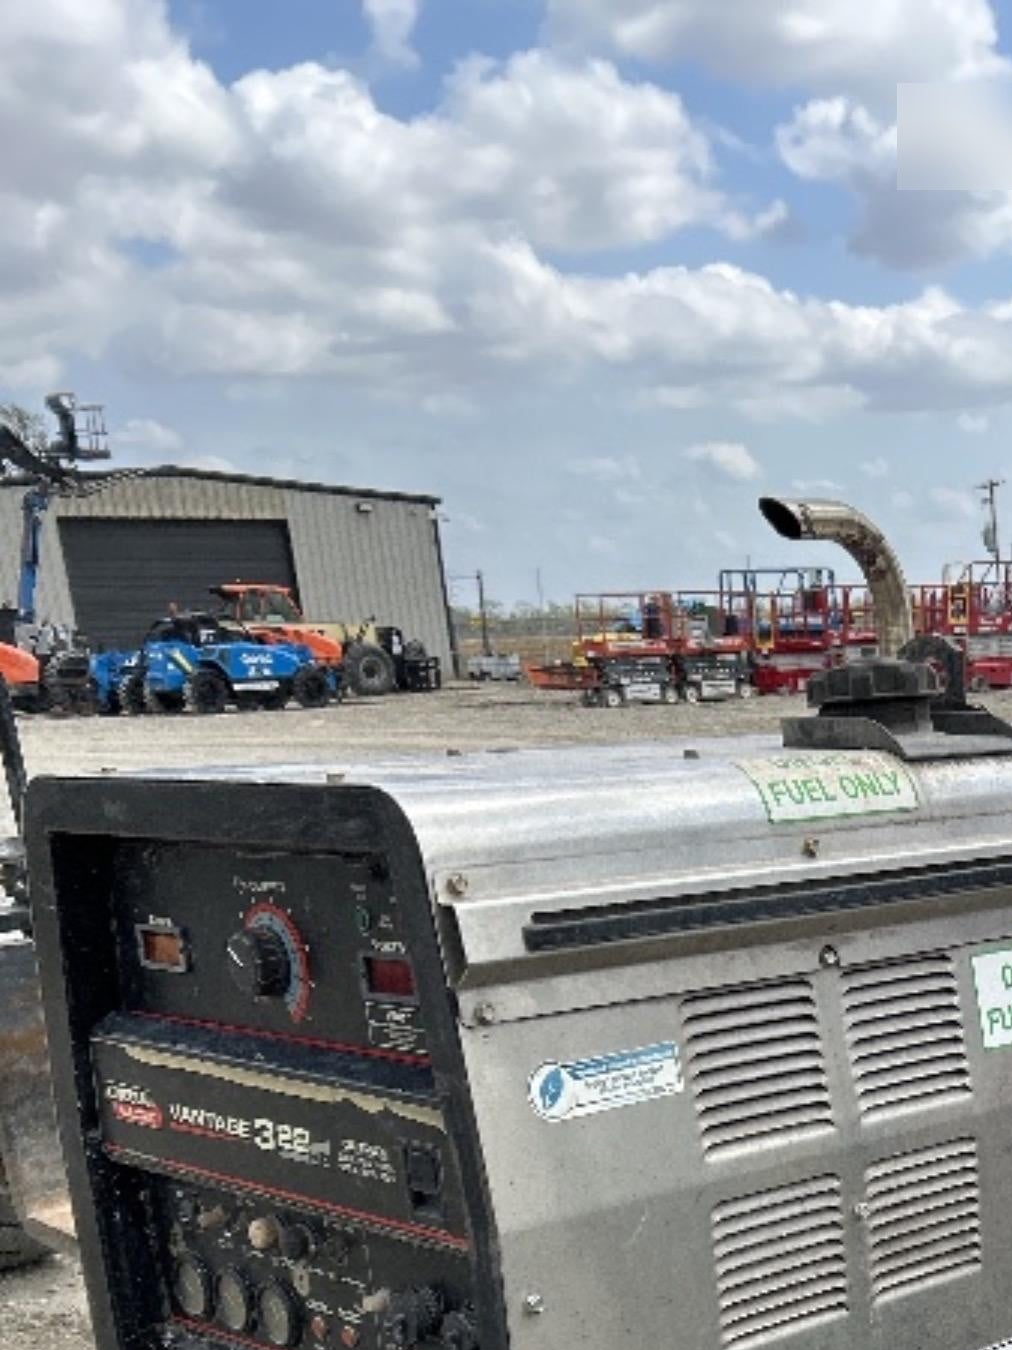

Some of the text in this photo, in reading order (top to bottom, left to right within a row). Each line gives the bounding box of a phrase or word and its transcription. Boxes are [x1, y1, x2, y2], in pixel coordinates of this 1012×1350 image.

[767, 770, 902, 807] FUEL ONLY
[169, 1104, 251, 1138] VANTAGE
